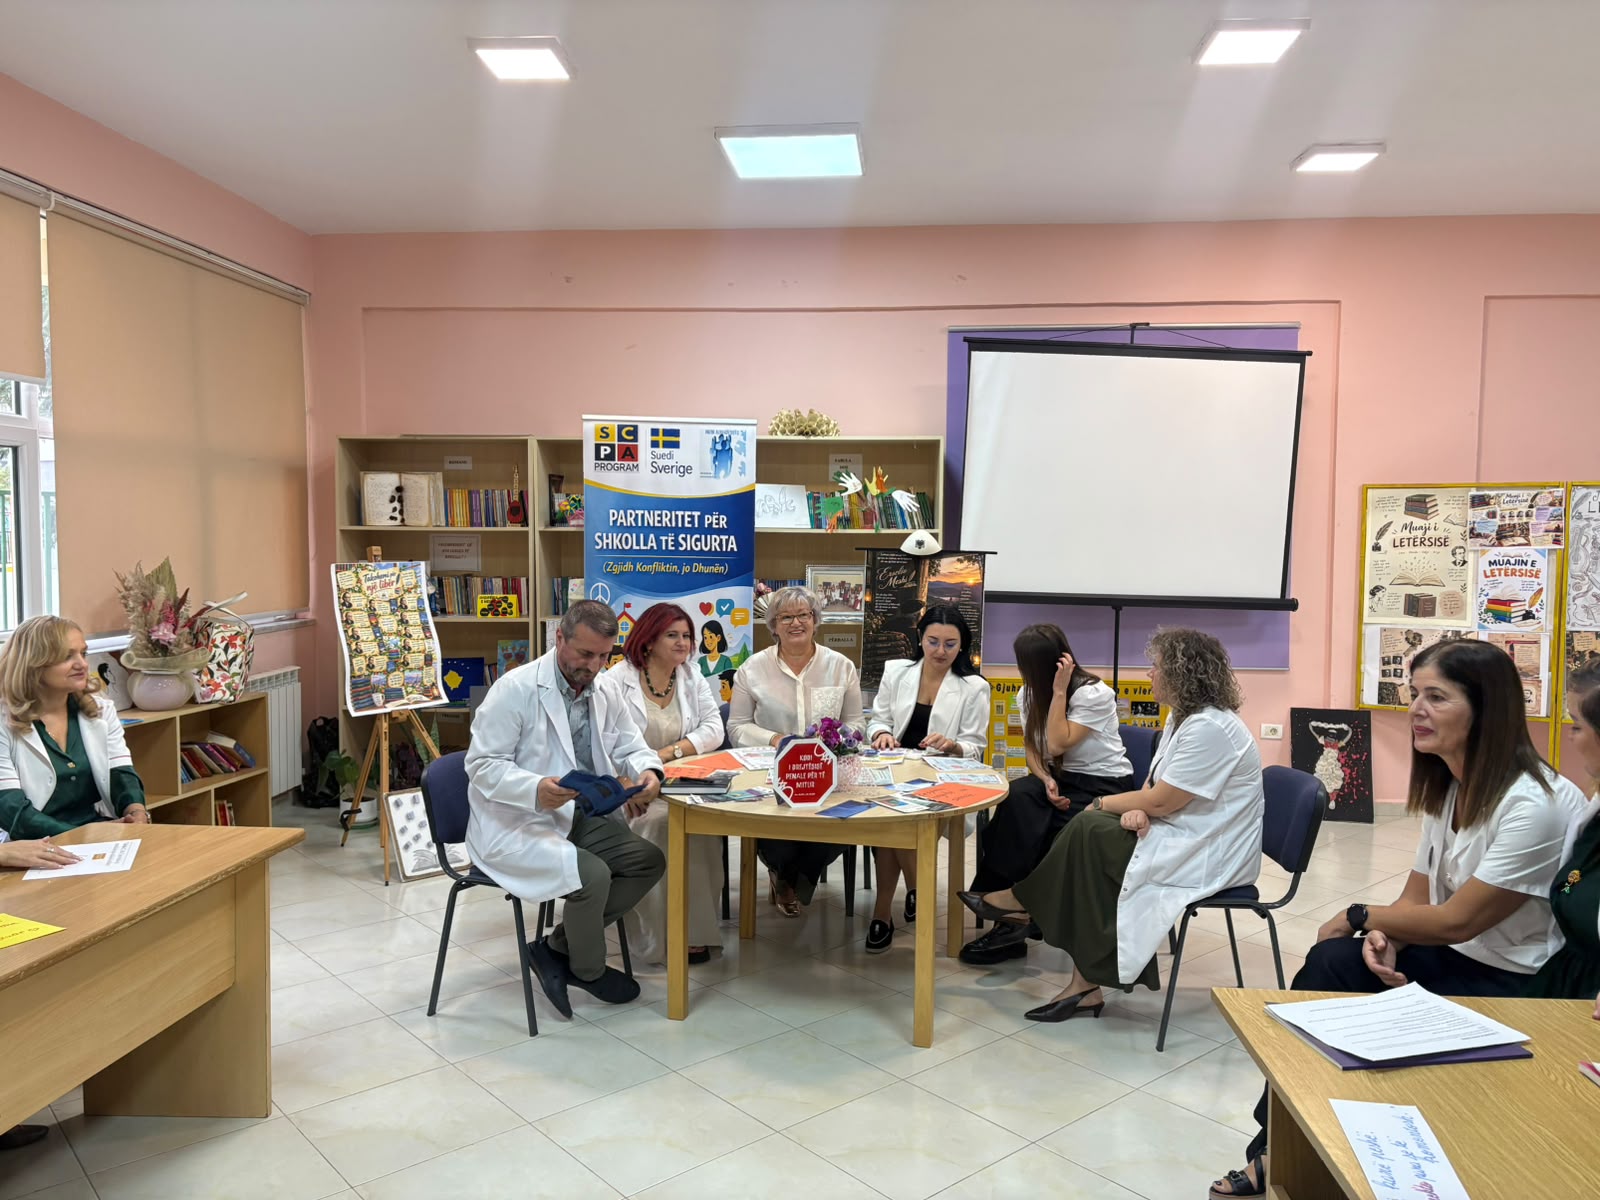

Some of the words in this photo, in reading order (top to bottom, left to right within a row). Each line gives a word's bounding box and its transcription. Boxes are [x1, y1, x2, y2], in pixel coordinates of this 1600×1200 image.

[599, 426, 610, 440] S
[621, 426, 635, 440] C
[600, 445, 612, 459] P
[621, 446, 635, 459] A
[650, 450, 674, 461] Suedi
[594, 462, 639, 472] PROGRAM
[650, 461, 693, 478] Sverige
[609, 509, 701, 528] PARTNERITET
[704, 511, 728, 529] PËR
[1400, 520, 1432, 536] Muaji
[1433, 522, 1439, 531] i
[594, 532, 657, 550] SHKOLLA
[659, 534, 675, 550] TË
[678, 533, 738, 552] SIGURTA
[1392, 535, 1450, 548] LETËRSISË
[603, 561, 634, 573] (Zgjidh
[636, 562, 680, 574] Konfliktin,
[682, 563, 690, 573] jo
[692, 563, 729, 575] Dhunën)
[1488, 559, 1528, 567] MUAJIN
[1530, 560, 1537, 568] E
[1483, 567, 1542, 579] LETËRSISË
[785, 772, 807, 780] PENALE
[807, 771, 818, 779] PËR
[819, 771, 826, 779] TË
